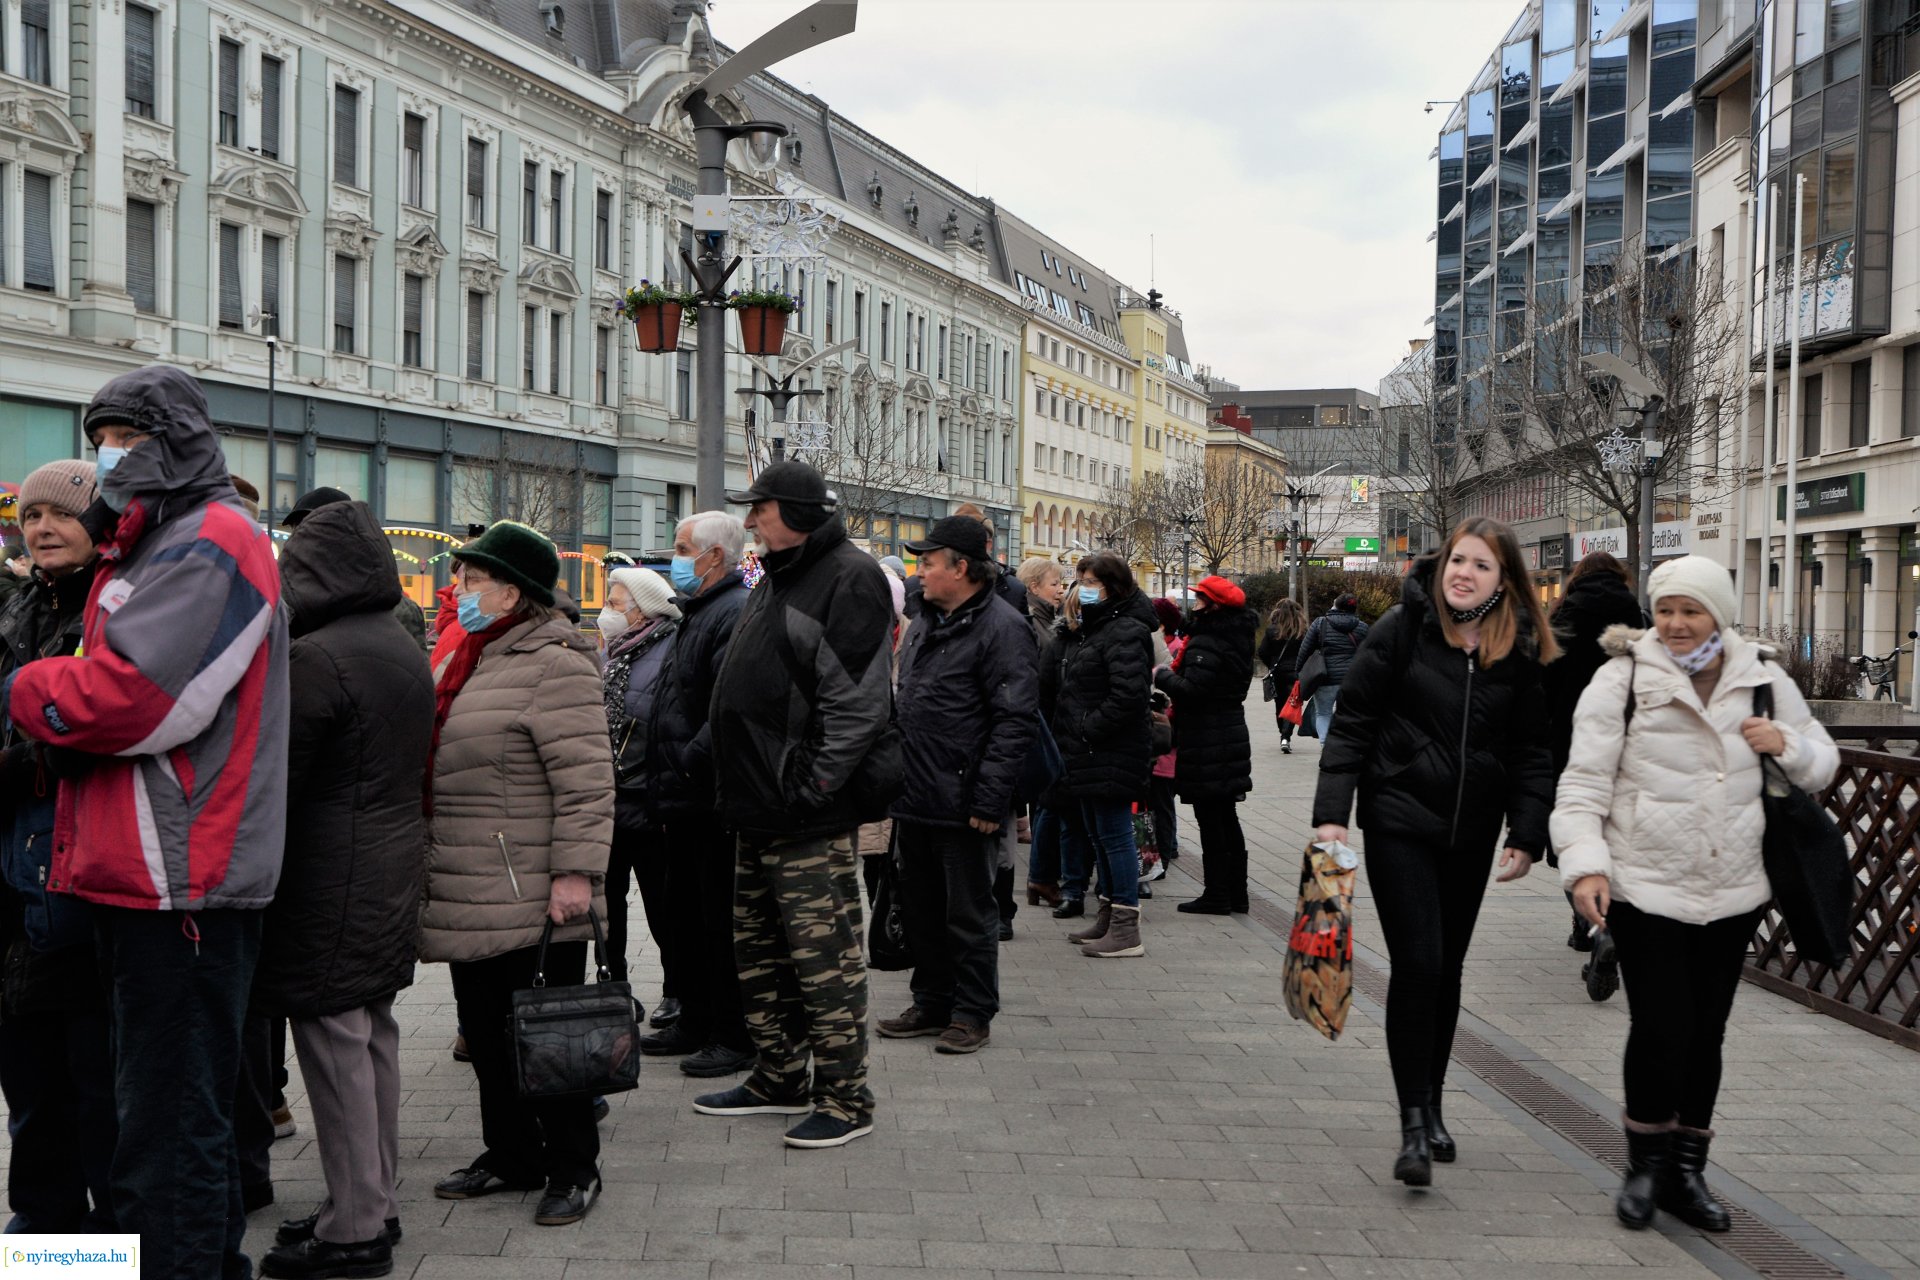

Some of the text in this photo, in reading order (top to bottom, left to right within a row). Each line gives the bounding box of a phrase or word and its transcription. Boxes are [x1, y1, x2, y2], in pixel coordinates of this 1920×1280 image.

[1606, 535, 1619, 553] Bank
[1667, 529, 1682, 547] Bank
[45, 705, 70, 732] SPORT
